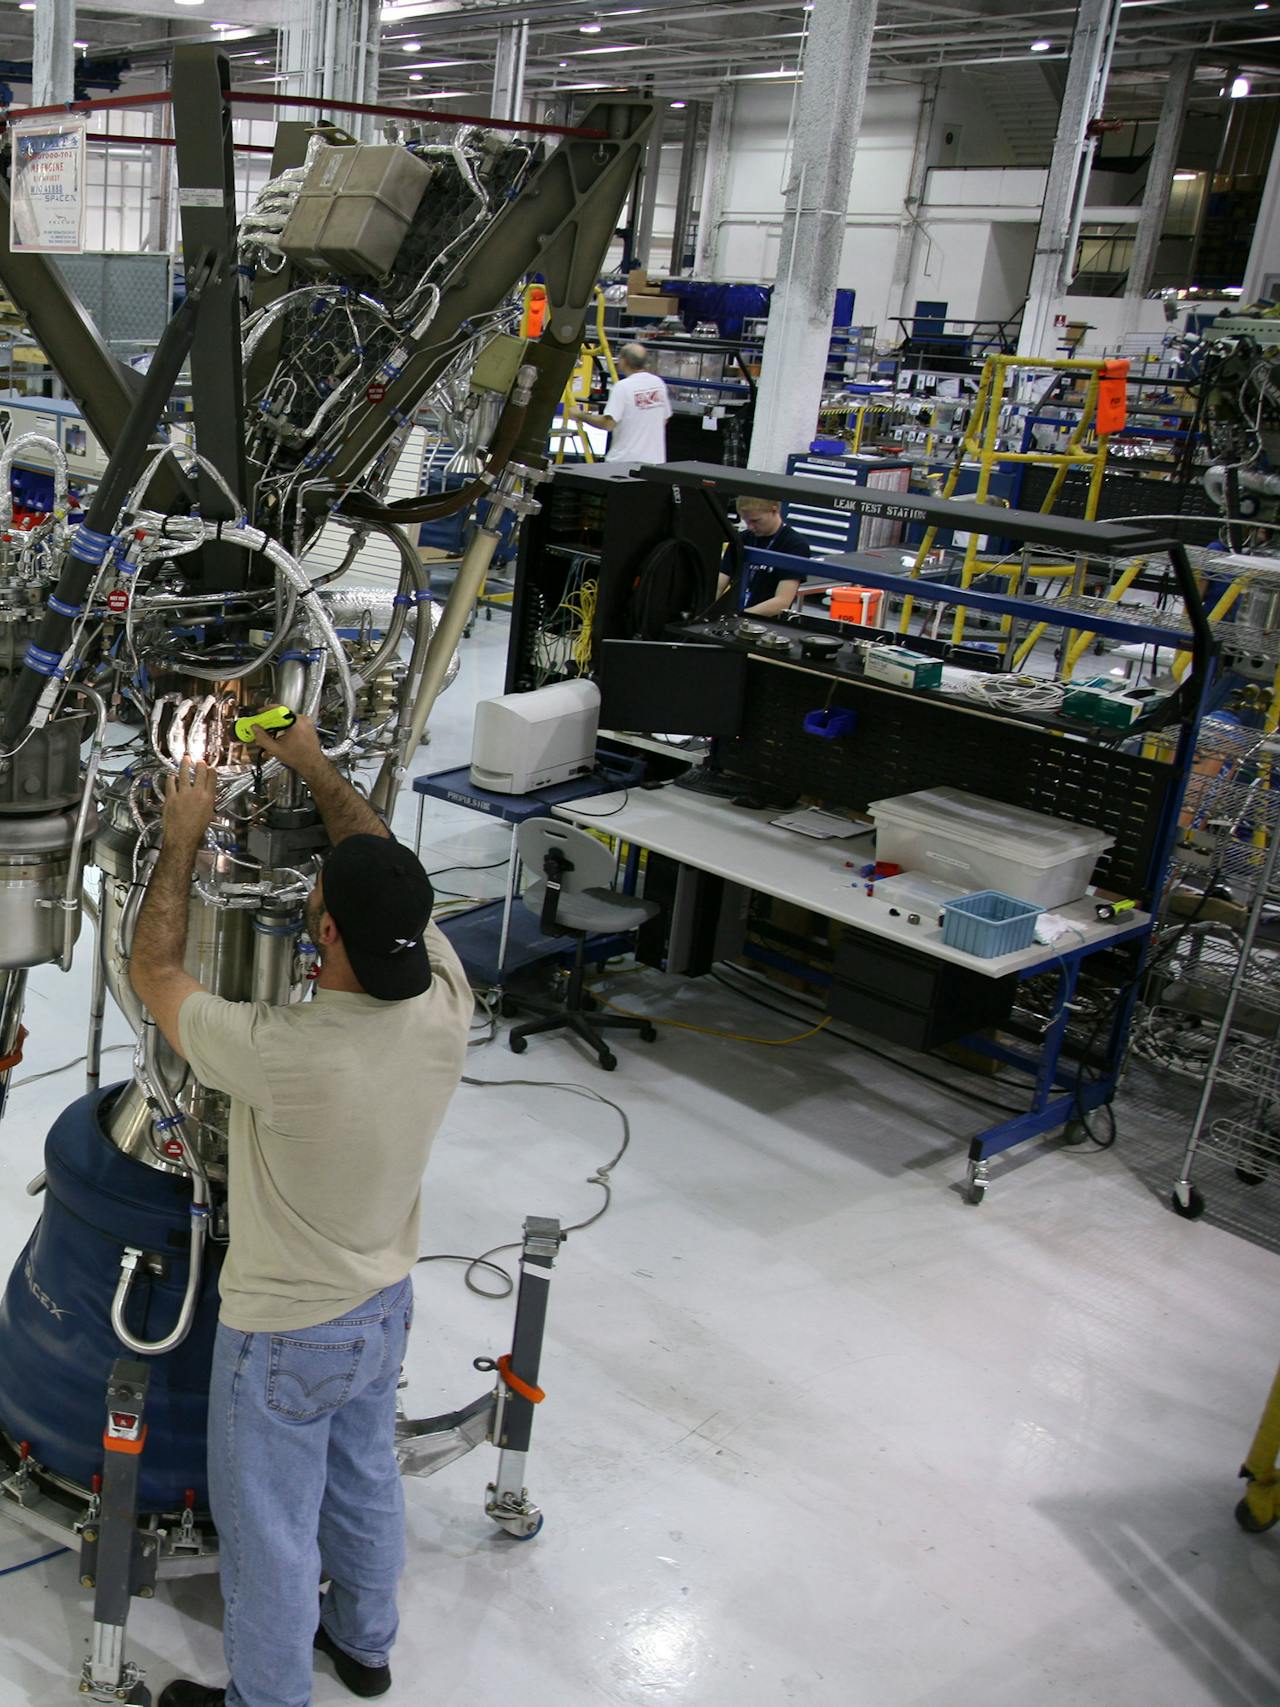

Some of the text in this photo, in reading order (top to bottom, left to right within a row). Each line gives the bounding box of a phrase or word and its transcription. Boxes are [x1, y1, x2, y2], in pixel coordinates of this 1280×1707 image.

[833, 498, 927, 520] LEAK TEST STATION
